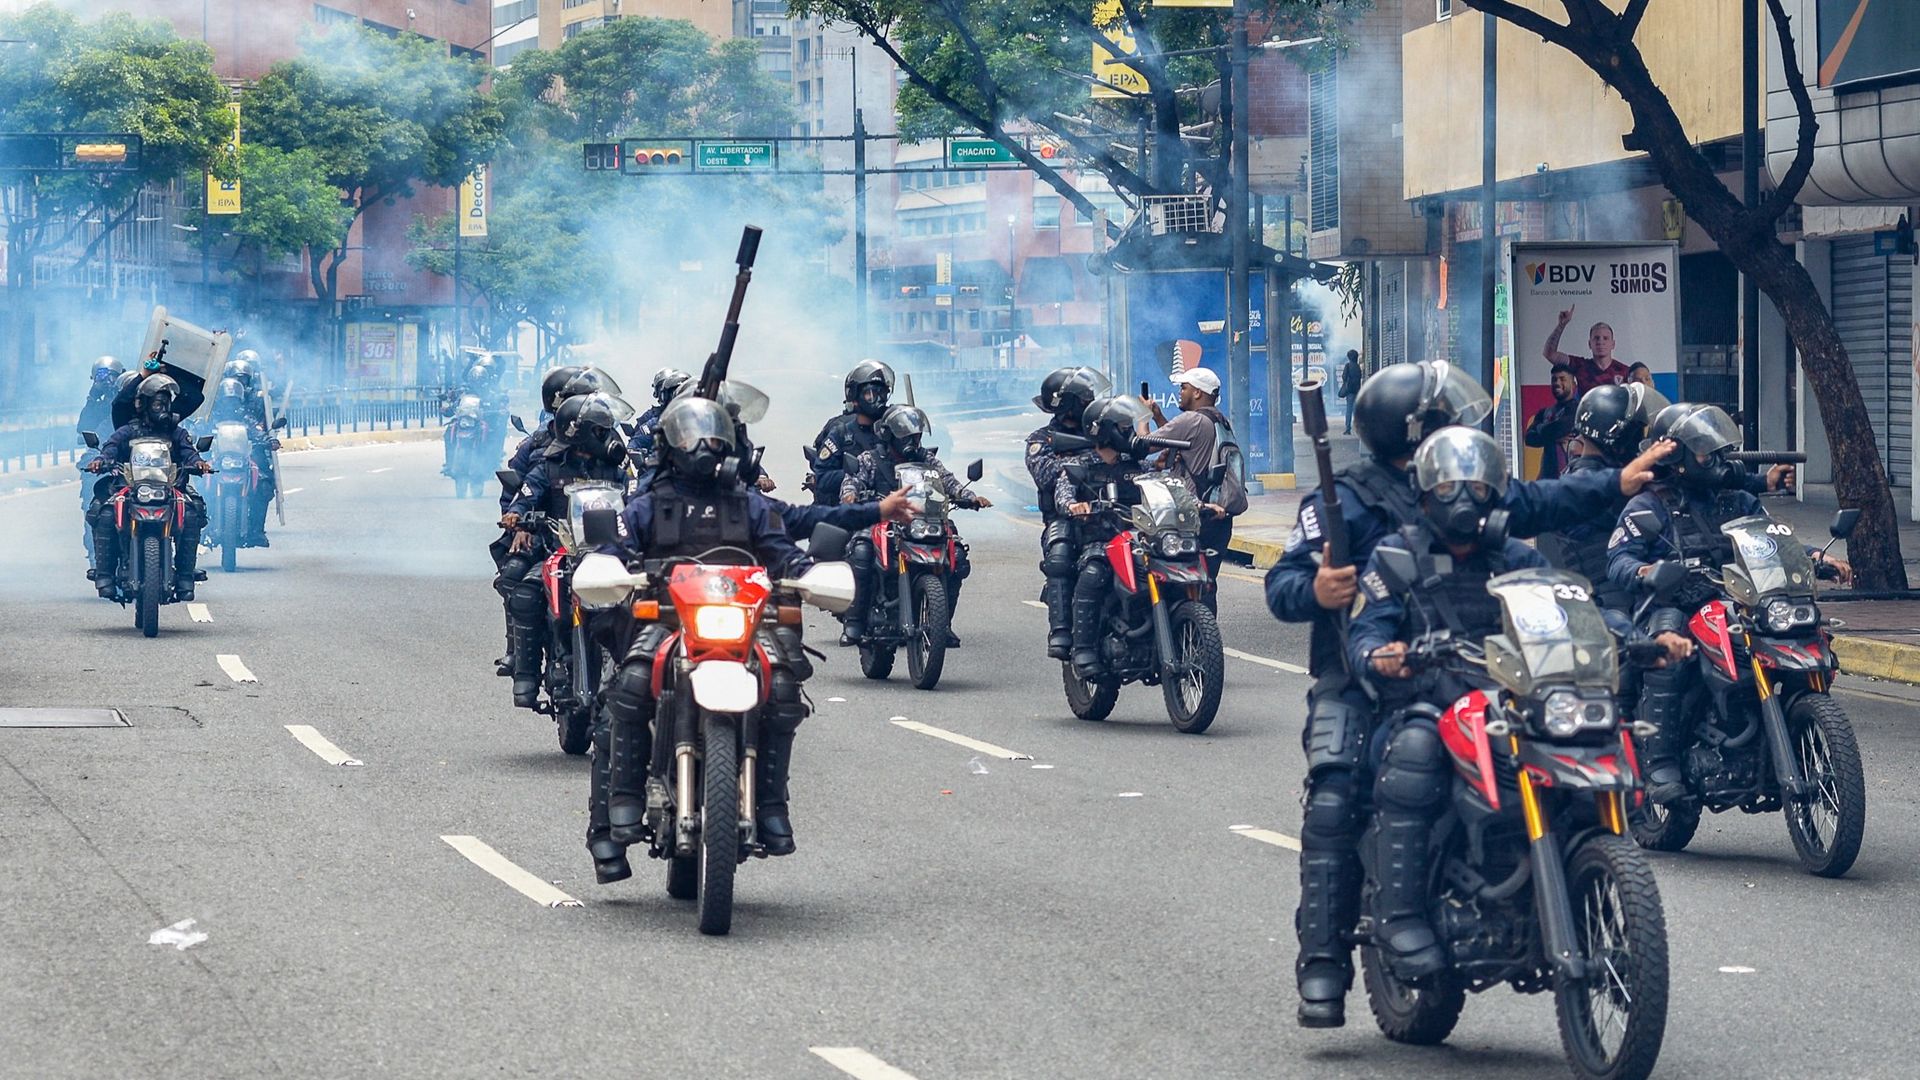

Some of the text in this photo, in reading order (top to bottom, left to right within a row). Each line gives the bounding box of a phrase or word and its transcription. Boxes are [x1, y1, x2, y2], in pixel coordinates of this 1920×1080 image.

[1110, 73, 1140, 86] EPA
[957, 147, 996, 156] CHACAITO
[706, 157, 728, 165] OESTE
[217, 199, 235, 207] EPA
[1549, 264, 1596, 283] BDV
[1560, 288, 1593, 296] Venezuela
[1164, 477, 1184, 488] 22
[1765, 524, 1792, 536] 40
[1553, 584, 1590, 602] 33
